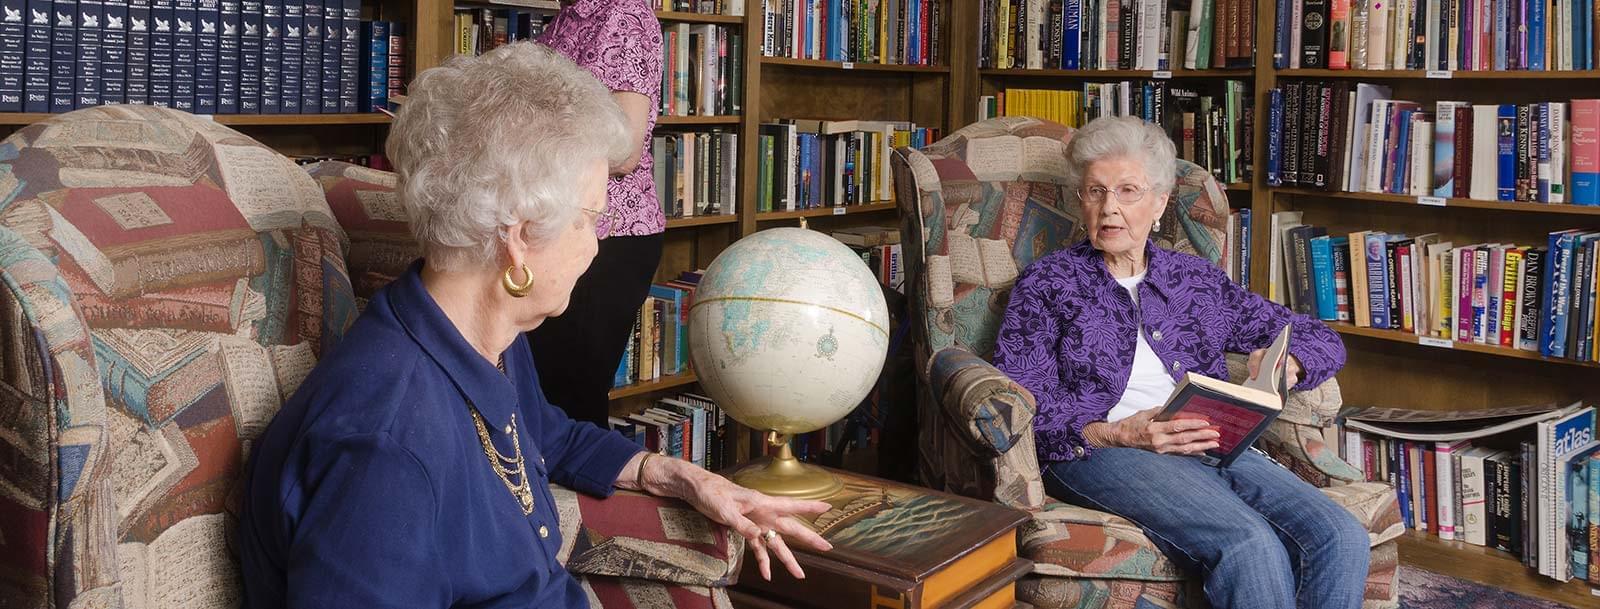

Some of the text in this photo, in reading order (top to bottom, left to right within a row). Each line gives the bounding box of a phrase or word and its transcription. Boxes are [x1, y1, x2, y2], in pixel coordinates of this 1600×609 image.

[1068, 0, 1079, 30] RUMAN
[1053, 14, 1061, 59] ROOSEVELT
[1170, 88, 1182, 97] Wild
[1519, 106, 1528, 164] ROSE KENNEDY
[1539, 105, 1547, 159] JIMMY CARTER
[1552, 108, 1560, 133] DADDY
[1244, 126, 1252, 161] Protection
[1289, 128, 1297, 171] ILLUSTRATED
[1476, 250, 1488, 275] Griffin
[1504, 252, 1522, 292] Griffin
[1561, 249, 1570, 273] Rivers
[1368, 262, 1384, 313] BARBARA BUSH
[1524, 252, 1539, 340] DAN BROWN DECEPTION
[1558, 283, 1567, 295] the
[1556, 296, 1565, 316] West
[1487, 319, 1496, 334] FIRE
[1520, 313, 1528, 332] POINT
[1556, 427, 1590, 458] atlas
